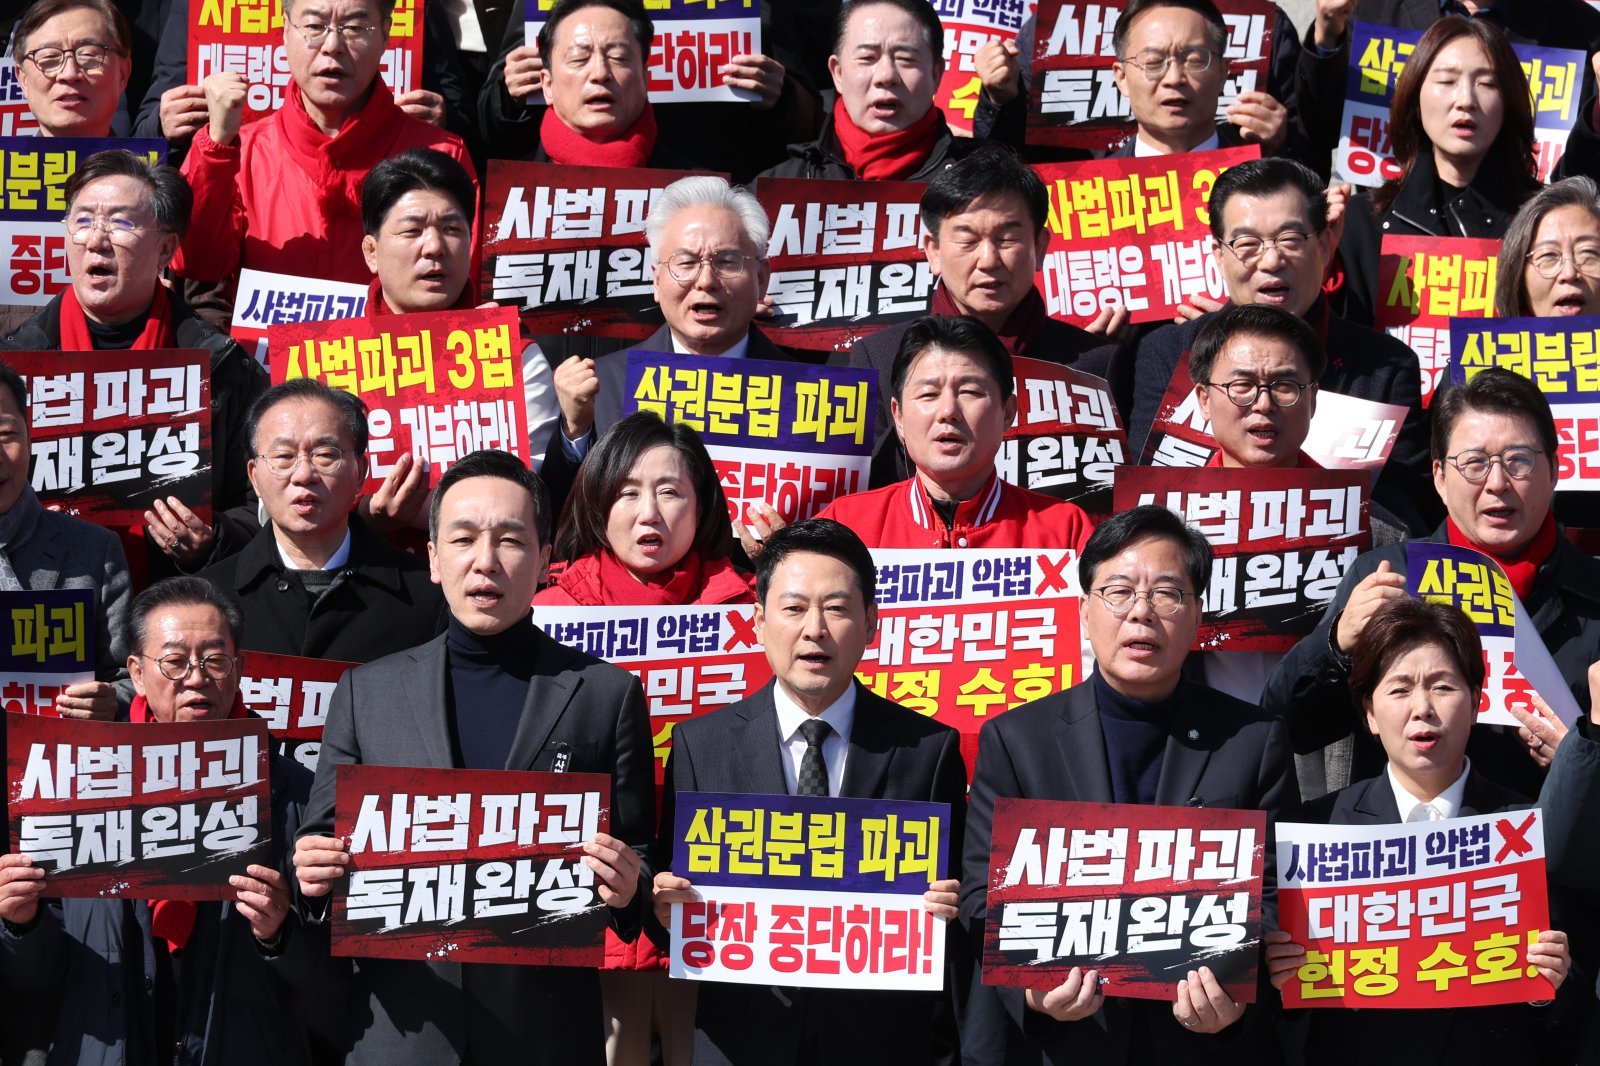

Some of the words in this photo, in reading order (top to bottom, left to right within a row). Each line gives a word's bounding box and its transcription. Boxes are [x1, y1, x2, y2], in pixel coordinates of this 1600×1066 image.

[494, 186, 605, 241] 사법
[767, 202, 877, 256] 사법
[1044, 170, 1183, 240] 사법파괴
[493, 249, 601, 308] 독재
[766, 265, 869, 325] 독재
[1043, 245, 1148, 316] 대통령은
[285, 330, 435, 397] 사법파괴
[446, 324, 514, 389] 3법
[21, 372, 84, 428] 법
[93, 365, 201, 420] 파괴
[634, 366, 781, 437] 삼권분립
[792, 379, 868, 444] 파괴
[1025, 378, 1119, 430] 파괴
[31, 437, 84, 492] 재
[91, 423, 200, 485] 완성
[1027, 436, 1124, 489] 완성
[1248, 486, 1361, 541] 파괴
[874, 561, 964, 603] 법파괴
[972, 556, 1031, 597] 악법
[1244, 546, 1358, 609] 완성
[11, 602, 84, 662] 파괴
[545, 618, 649, 658] 법파괴
[657, 612, 720, 653] 악법
[862, 608, 1058, 665] 대한민국
[20, 743, 132, 799] 사법
[142, 735, 258, 794] 파괴
[20, 809, 133, 871] 독재
[141, 795, 258, 860] 완성
[349, 793, 471, 852] 사법
[478, 792, 600, 848] 파괴
[685, 807, 845, 879] 삼권분립
[859, 814, 940, 883] 파괴
[1284, 835, 1417, 882] 사법파괴
[1425, 823, 1490, 870] 악법
[1003, 827, 1128, 887] 사법
[1134, 827, 1256, 882] 파괴
[347, 863, 466, 930] 독재
[473, 855, 595, 919] 완성
[1308, 873, 1521, 944] 대한민국
[681, 900, 757, 971] 당장
[769, 904, 933, 975] 중단하라!
[999, 898, 1121, 961] 독재
[1126, 892, 1250, 955] 완성
[1297, 946, 1399, 999] 헌정
[1417, 929, 1540, 991] 수호!
